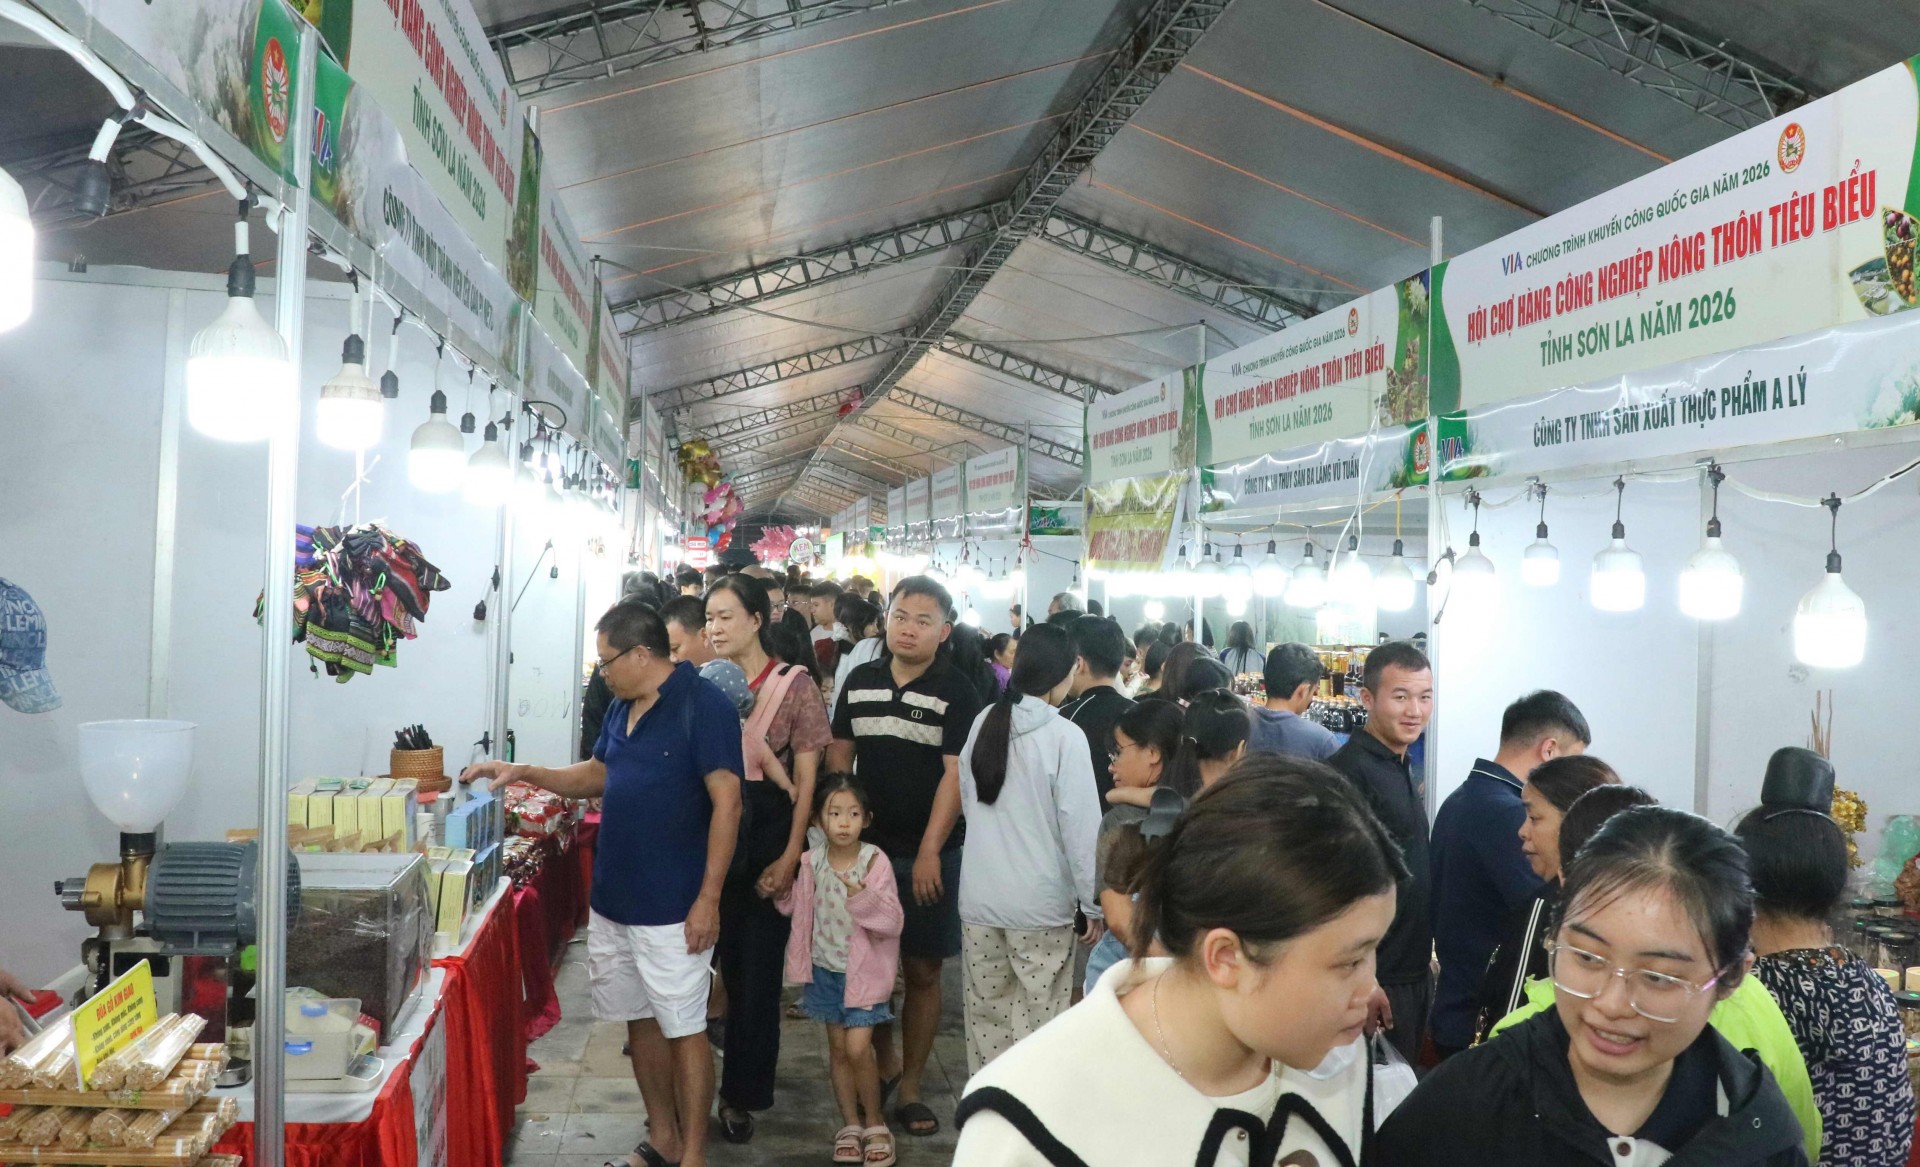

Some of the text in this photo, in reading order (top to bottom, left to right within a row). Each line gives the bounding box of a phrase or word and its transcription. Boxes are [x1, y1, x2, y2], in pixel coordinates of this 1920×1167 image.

[413, 77, 486, 221] TỈNH SƠN LA NĂM 2026
[383, 184, 405, 237] CÔNG
[1502, 160, 1770, 276] VIA CHƯƠNG TRÌNH KHUYẾN CÔNG QUỐC GIA NĂM 2026
[1467, 158, 1876, 347] HỘI CHỢ HÀNG CÔNG NGHIỆP NÔNG THÔN TIÊU BIỂU
[1231, 362, 1242, 377] VIA
[1334, 328, 1346, 340] 2026
[1540, 287, 1736, 367] TỈNH SƠN LA NĂM 2026
[1238, 386, 1255, 412] HÀNG
[1256, 377, 1273, 407] CÔNG
[1274, 370, 1299, 402] NGHIỆP
[1300, 364, 1320, 394] NÔNG
[1322, 355, 1342, 387] THÔN
[1345, 348, 1362, 381] TIÊU
[1365, 336, 1385, 374] BIỂU
[1533, 416, 1562, 448] CÔNG
[1564, 416, 1579, 442] TY
[1580, 411, 1610, 441] TNHH
[1643, 388, 1676, 431] XUẤT
[1681, 387, 1716, 429] THỰC
[1721, 369, 1767, 418] PHẨM
[1772, 377, 1783, 410] A
[1788, 365, 1807, 407] LÝ
[1249, 401, 1333, 440] TỈNH SƠN LA NĂM 2026
[1441, 436, 1464, 463] VIA
[1244, 474, 1258, 495] CÔNG
[1258, 476, 1264, 493] TY
[1306, 467, 1315, 486] BA
